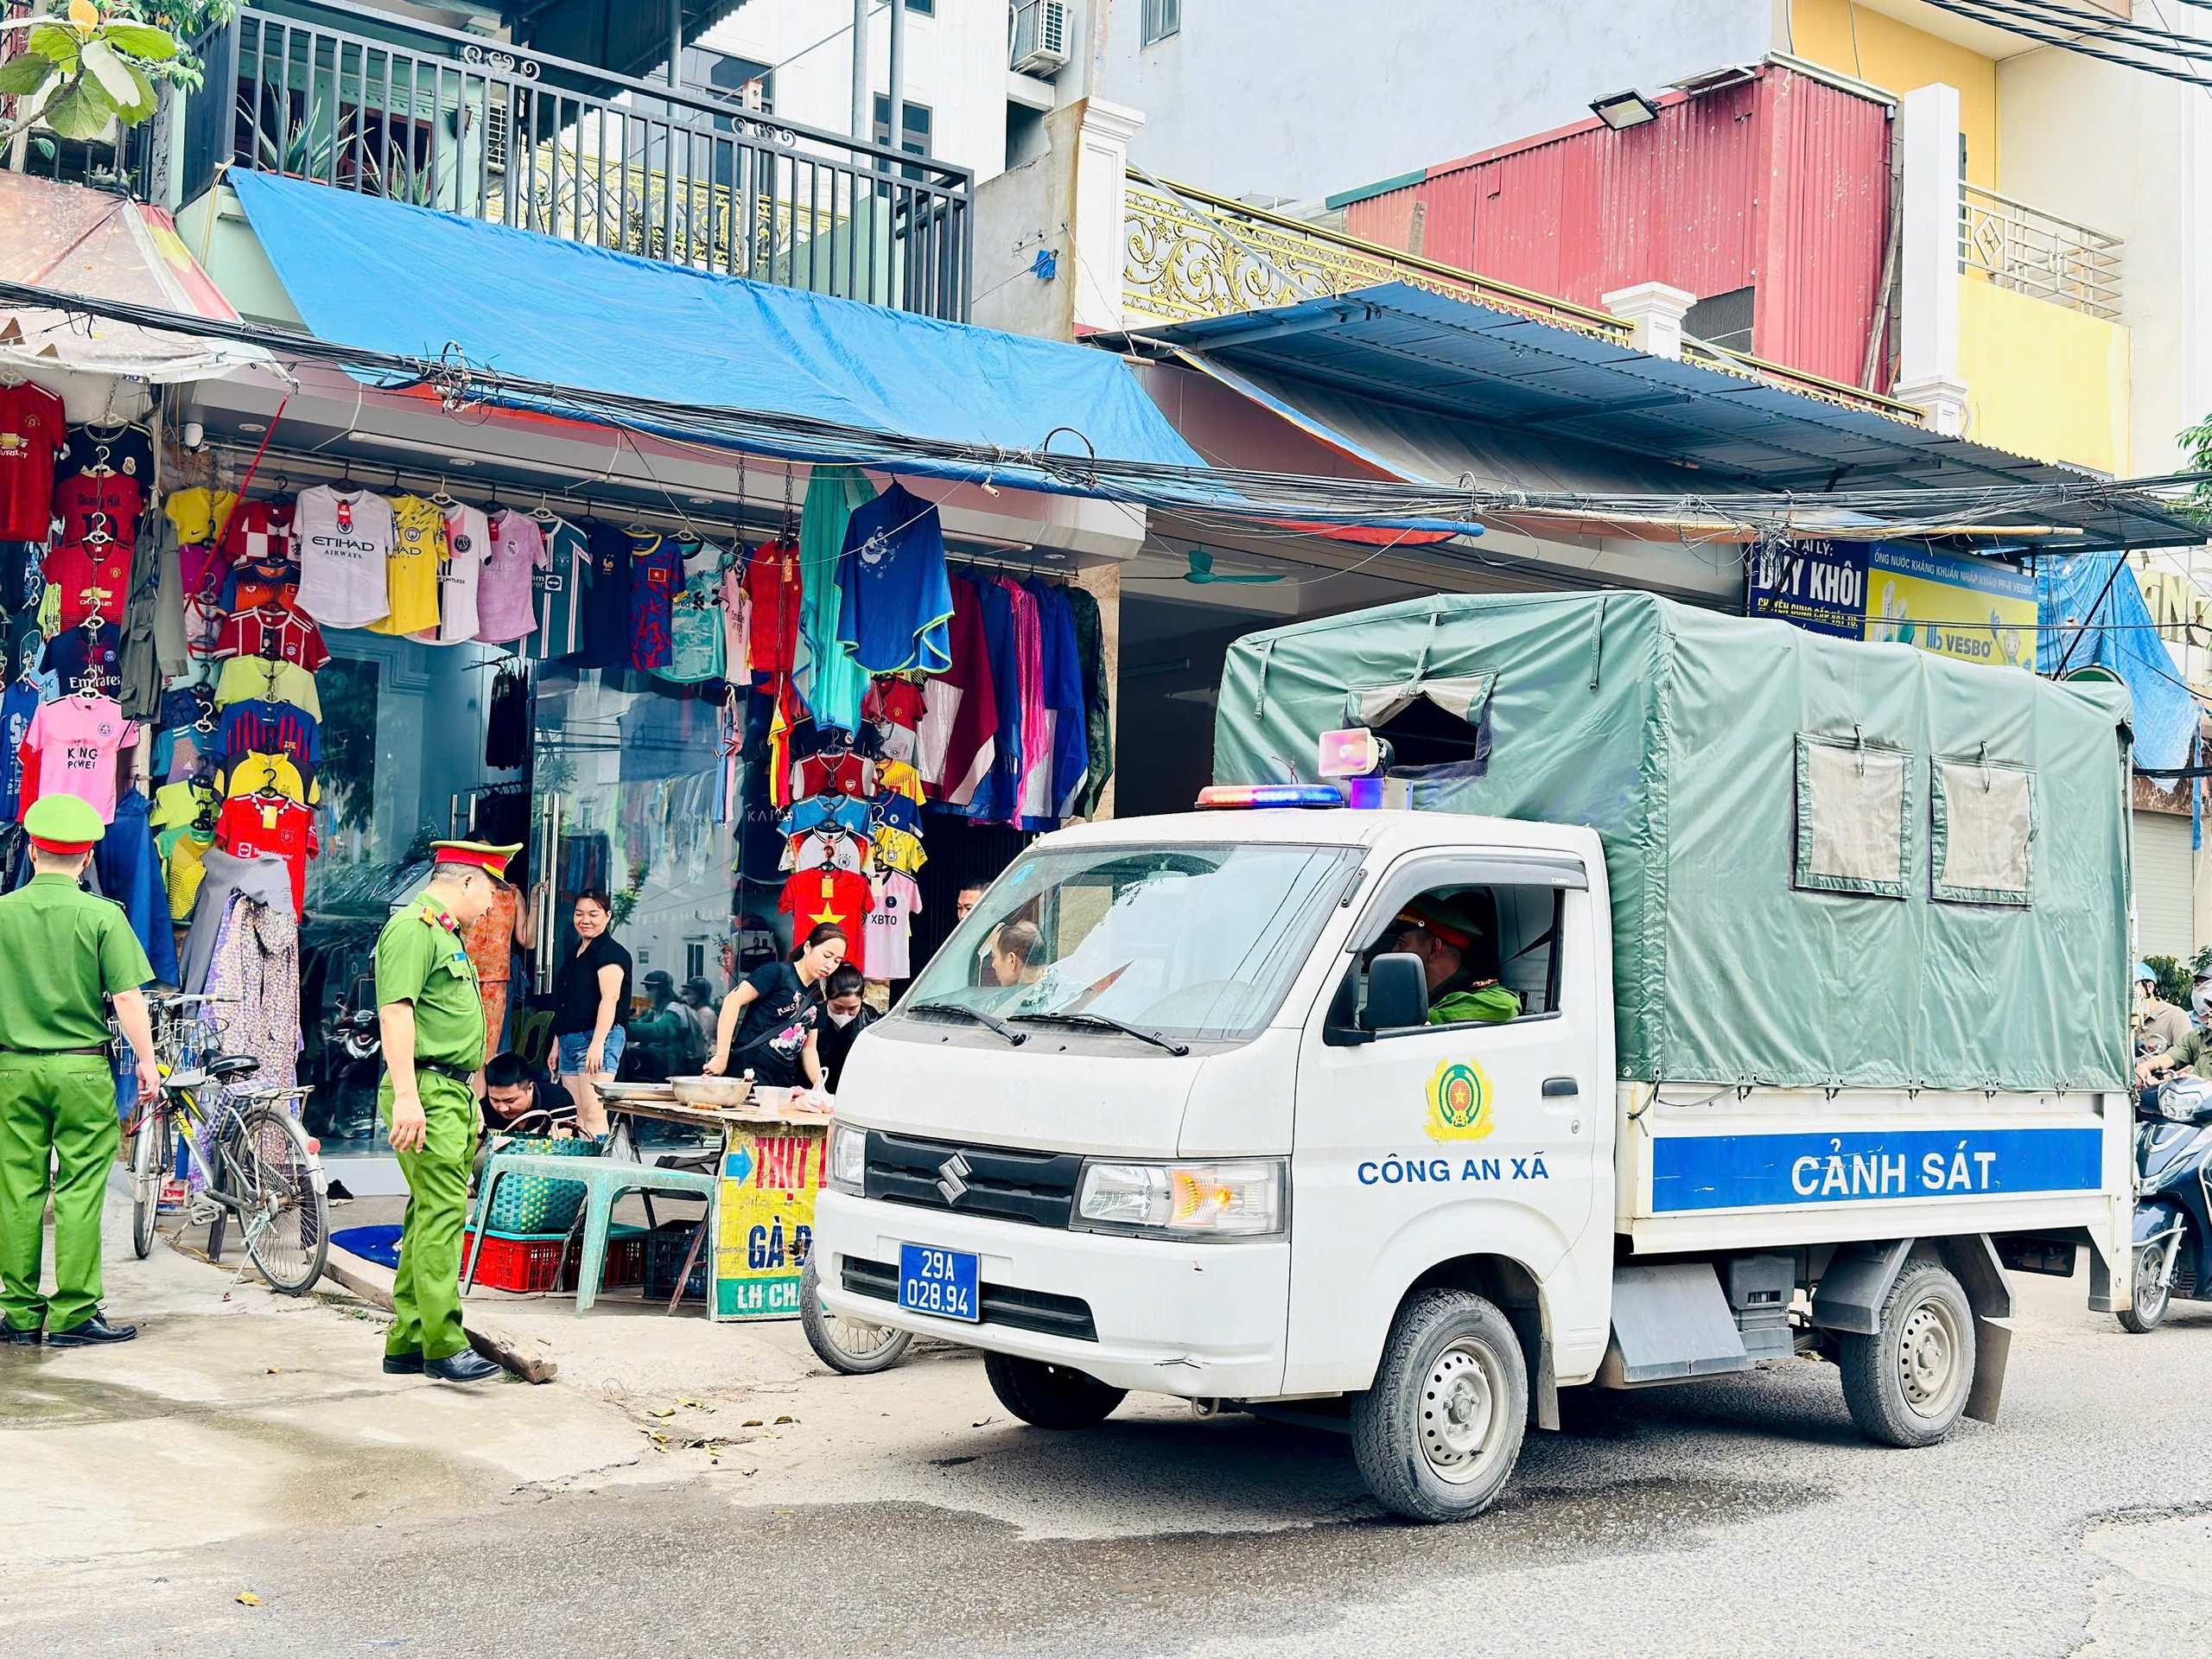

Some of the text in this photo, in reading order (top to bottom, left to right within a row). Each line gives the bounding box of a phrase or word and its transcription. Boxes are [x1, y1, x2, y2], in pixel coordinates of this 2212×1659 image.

[312, 536, 375, 552] ETIHAD
[324, 549, 362, 559] AIRWAYS
[1809, 560, 1862, 608] KHÔI
[1946, 634, 1991, 658] VESBO
[69, 676, 121, 689] Emrates
[871, 914, 898, 925] XBTO
[754, 1137, 812, 1201] THỊT
[1357, 1151, 1550, 1185] CÔNG AN XÃ
[1791, 1137, 1997, 1196] CẢNH SÁT
[748, 1215, 785, 1269] GÀ
[921, 1250, 955, 1281] 29A
[737, 1284, 764, 1308] LH
[907, 1278, 969, 1314] 028.94
